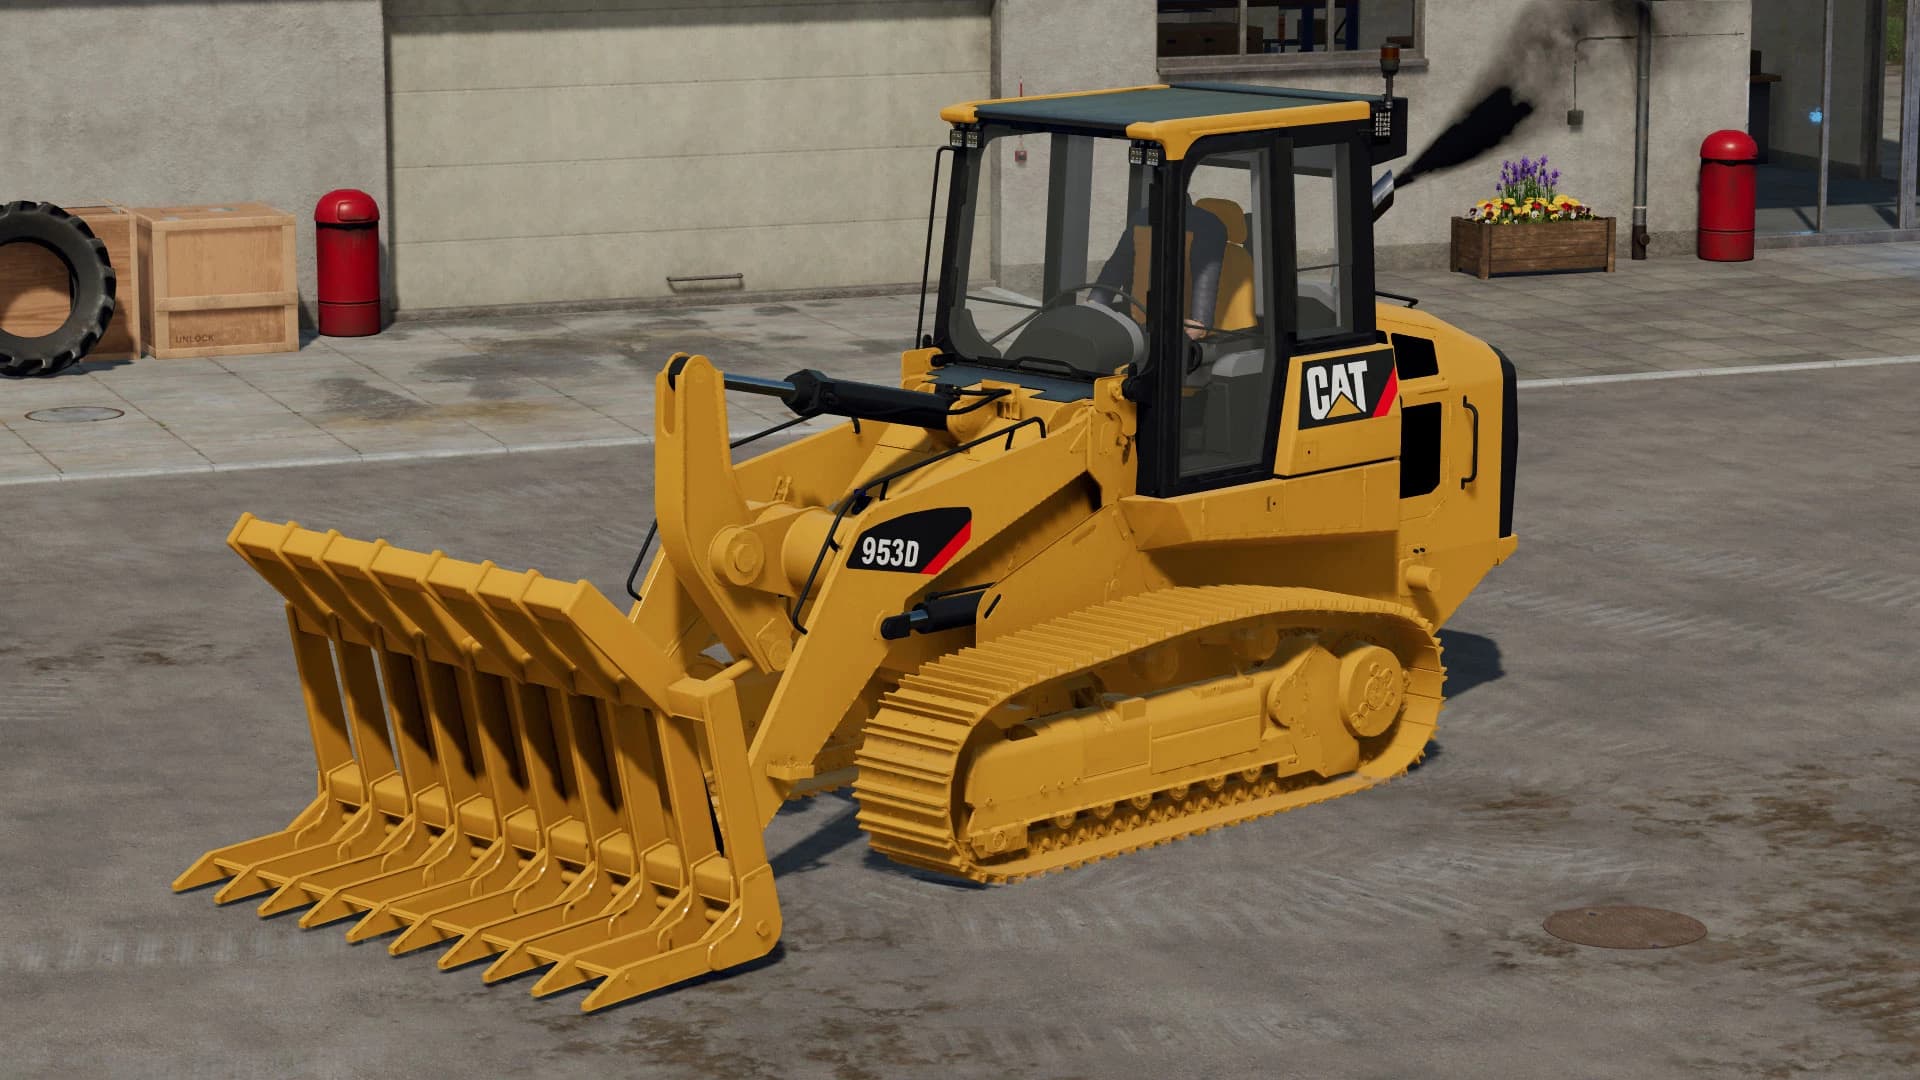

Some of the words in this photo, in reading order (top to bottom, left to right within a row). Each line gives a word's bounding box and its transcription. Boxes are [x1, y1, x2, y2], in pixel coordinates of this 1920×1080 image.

[175, 334, 214, 344] UNLOCK
[1307, 360, 1368, 420] CAT
[862, 537, 919, 567] 953D
